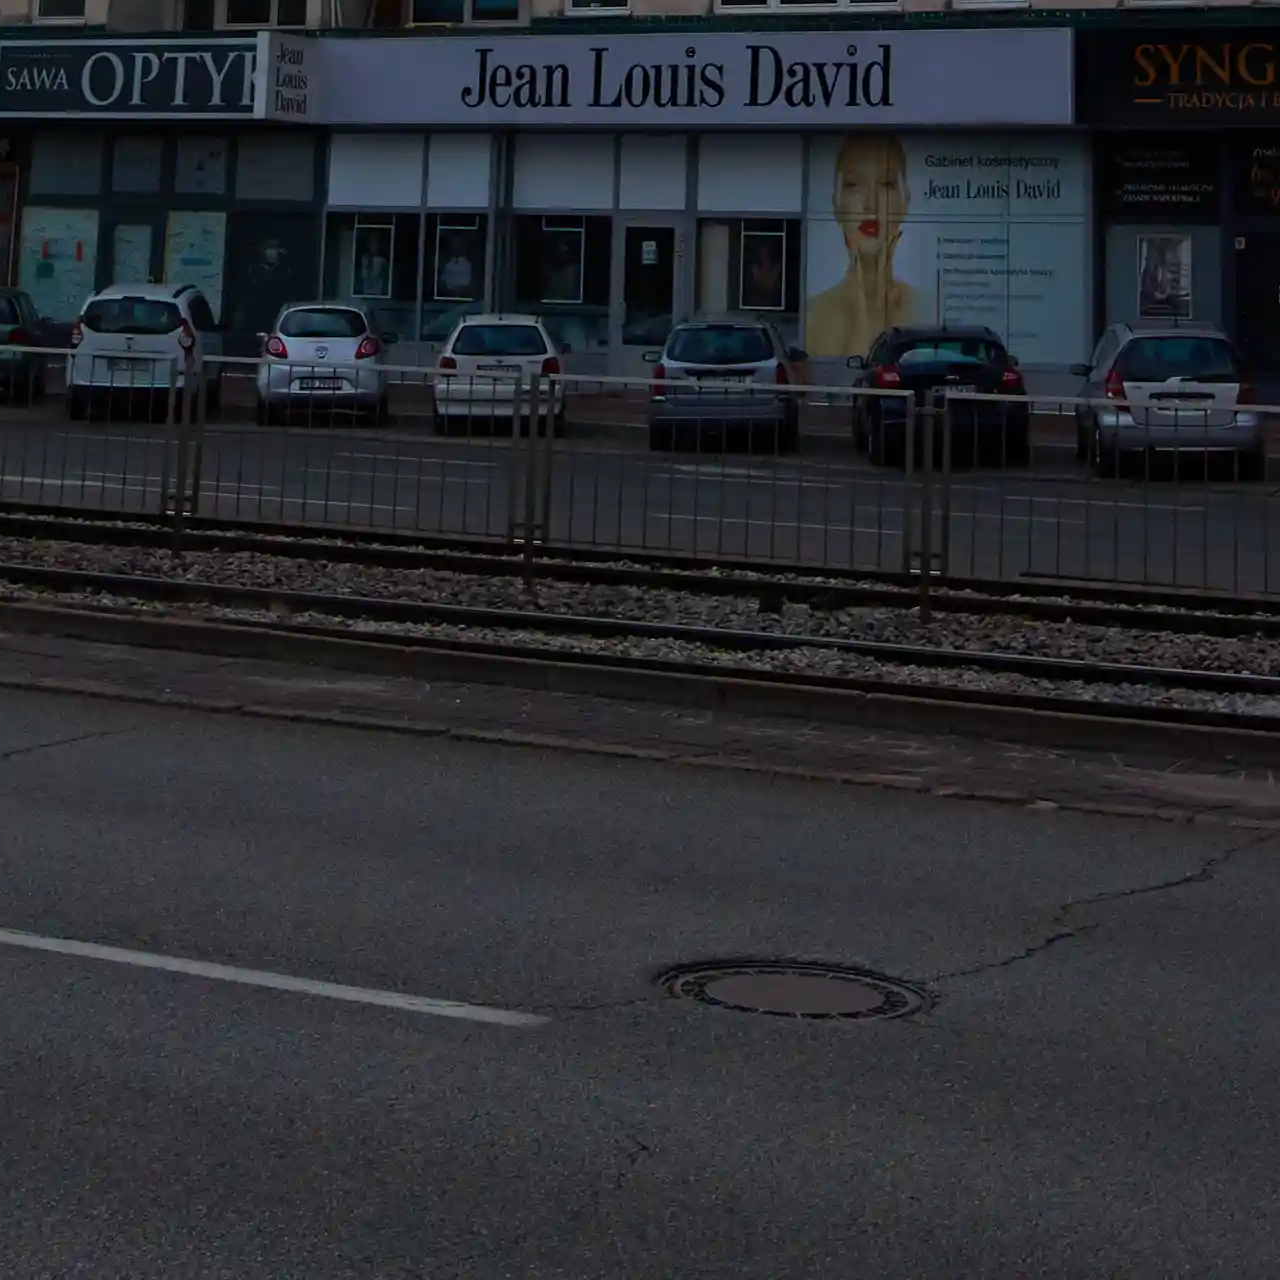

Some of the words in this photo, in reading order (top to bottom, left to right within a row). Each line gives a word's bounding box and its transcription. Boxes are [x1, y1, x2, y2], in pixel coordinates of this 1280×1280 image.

[276, 42, 304, 66] Jean
[6, 67, 69, 90] SAWA
[275, 67, 308, 90] Louis
[461, 48, 571, 108] Jean
[588, 47, 724, 107] Louis
[743, 44, 895, 107] David
[275, 93, 307, 116] David
[1166, 90, 1255, 112] TRADYCJA
[925, 155, 974, 167] Gabinet
[977, 155, 1060, 169] kosmetyczny
[924, 180, 960, 200] Jean
[966, 180, 1009, 200] Louis
[1016, 180, 1060, 200] David
